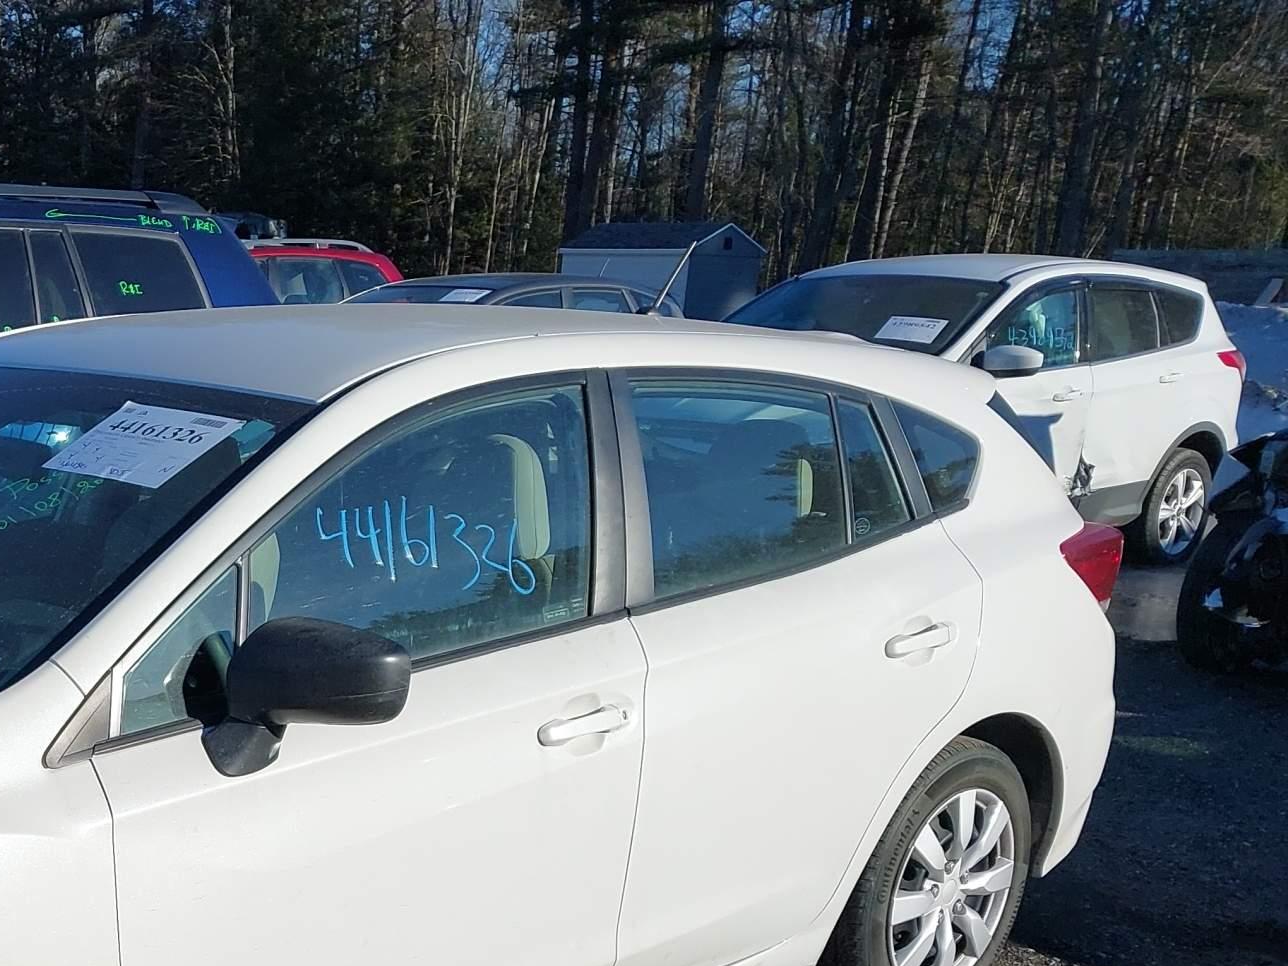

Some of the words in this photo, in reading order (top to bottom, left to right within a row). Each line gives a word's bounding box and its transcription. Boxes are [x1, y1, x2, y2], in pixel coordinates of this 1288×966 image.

[109, 419, 210, 445] 44161326
[316, 495, 536, 595] 44161326
[877, 817, 915, 904] Continental
